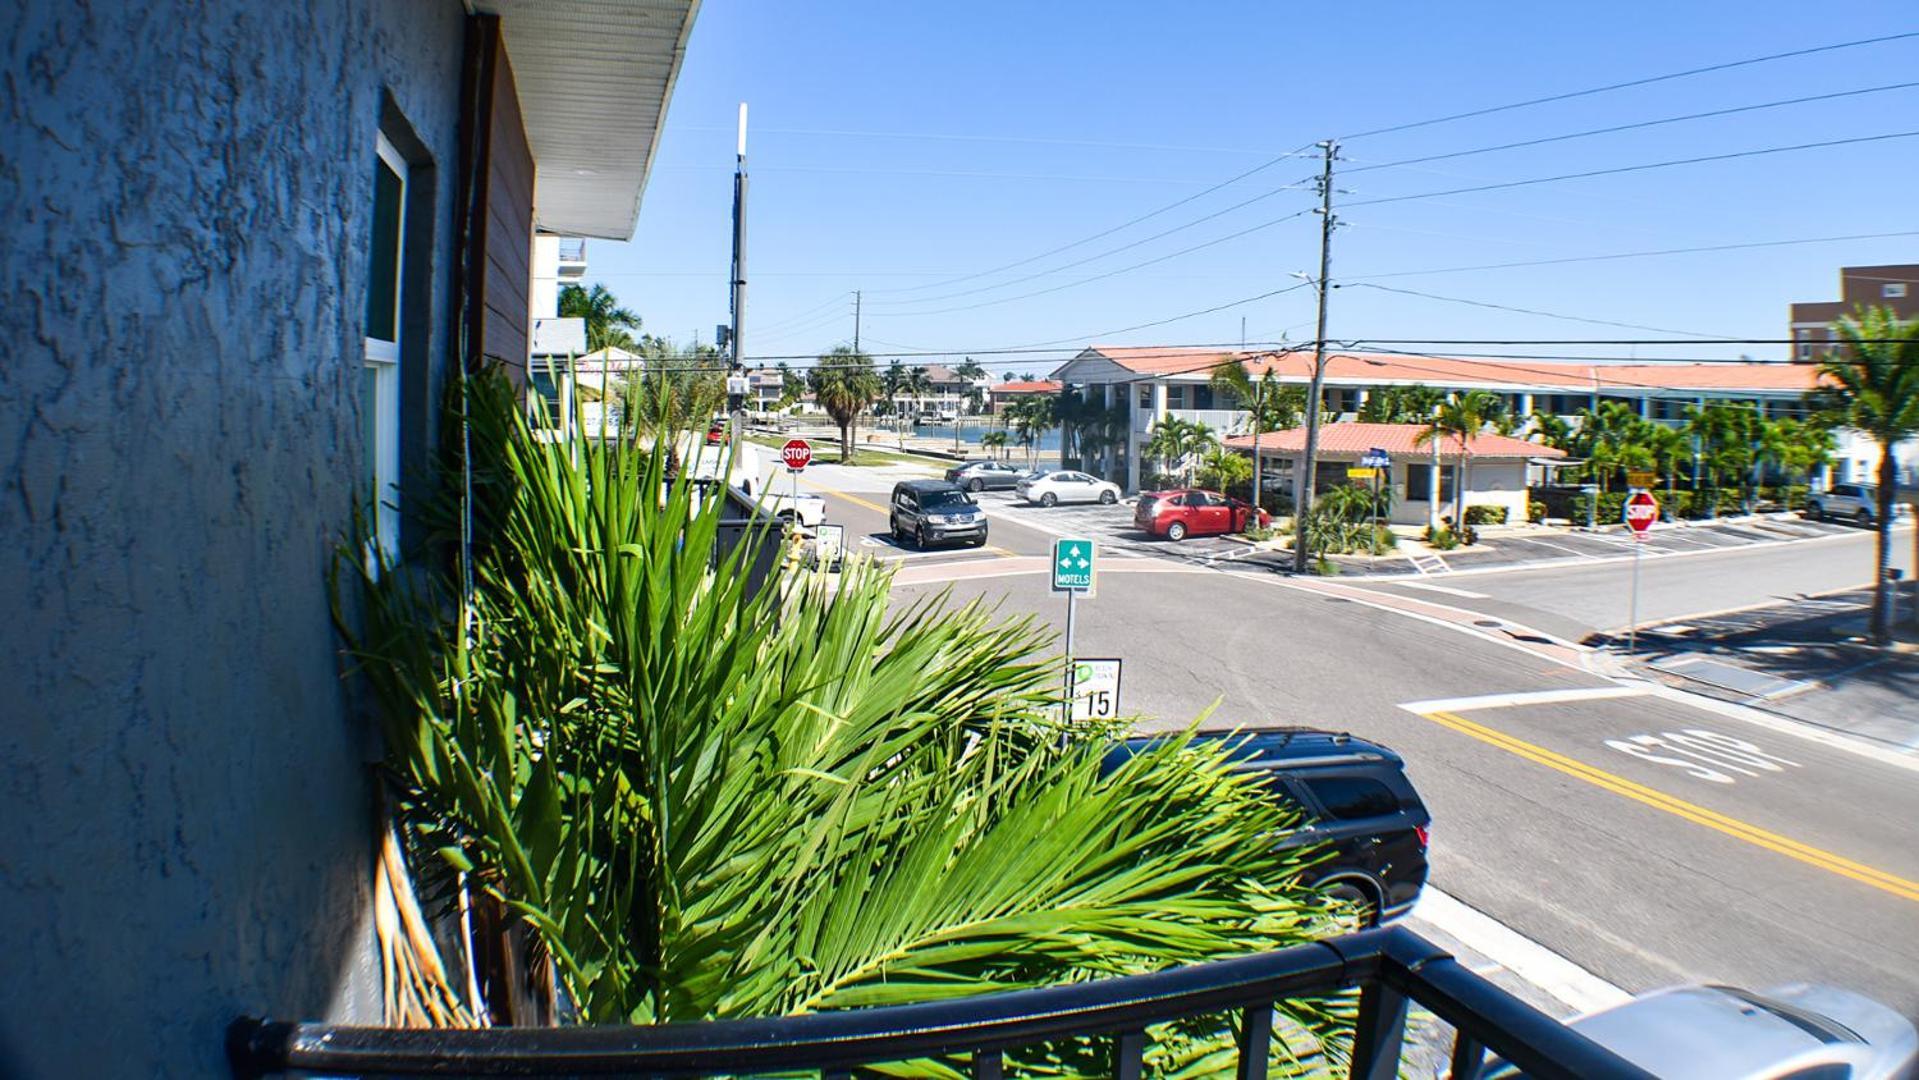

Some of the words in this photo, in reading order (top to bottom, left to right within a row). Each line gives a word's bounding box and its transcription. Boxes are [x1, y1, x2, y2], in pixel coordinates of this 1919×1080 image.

[784, 448, 809, 460] STOP
[1627, 504, 1656, 519] STOP
[1057, 574, 1090, 585] MOTELS
[1088, 690, 1110, 716] 15
[1603, 729, 1803, 783] STOP
